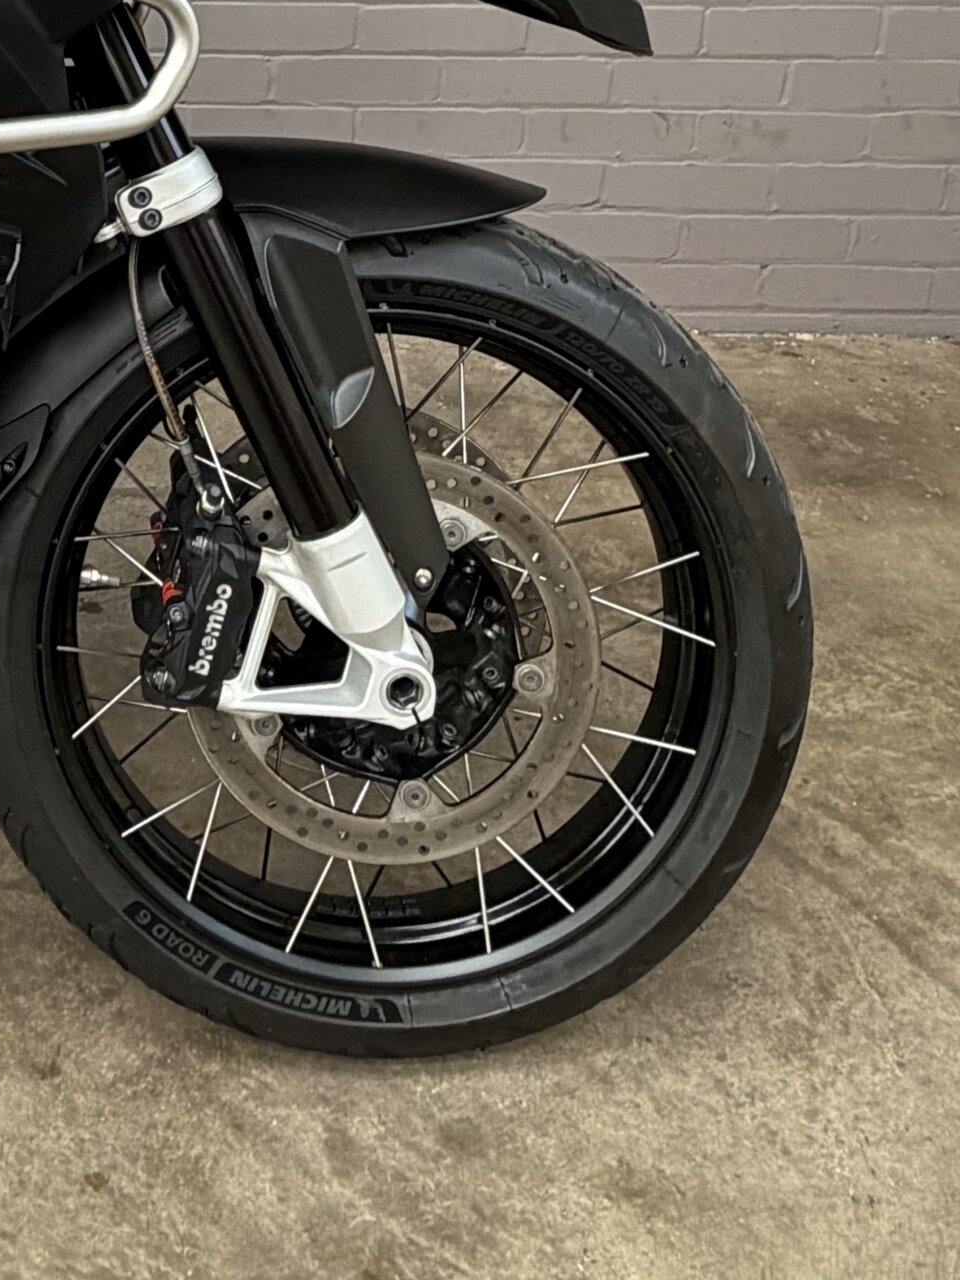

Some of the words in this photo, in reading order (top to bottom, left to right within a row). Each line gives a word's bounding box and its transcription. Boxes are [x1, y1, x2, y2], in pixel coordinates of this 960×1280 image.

[188, 582, 233, 677] brembo
[137, 908, 151, 924] 6
[151, 924, 210, 966] ROAD
[229, 969, 353, 1016] MICHELIN
